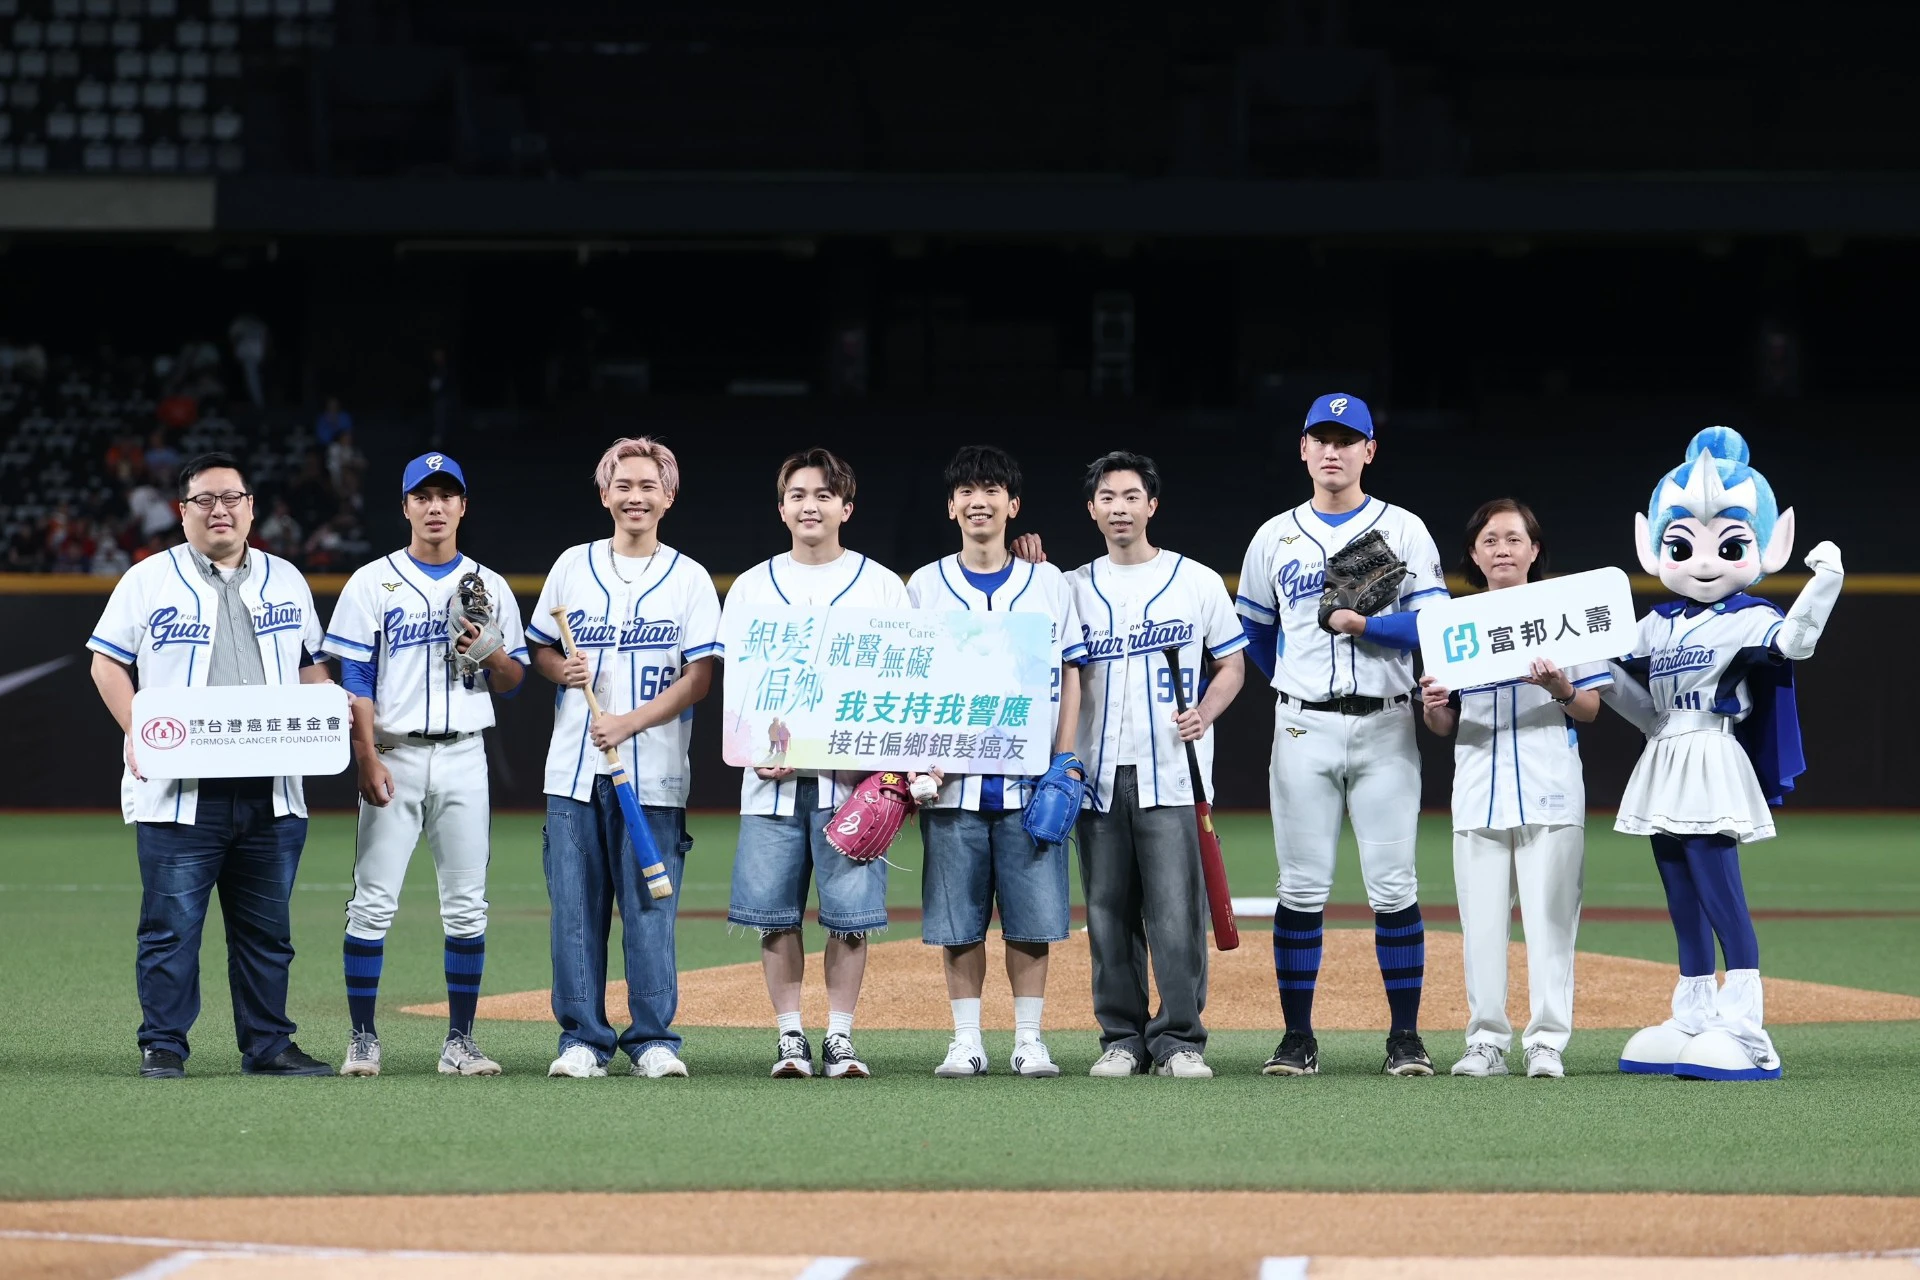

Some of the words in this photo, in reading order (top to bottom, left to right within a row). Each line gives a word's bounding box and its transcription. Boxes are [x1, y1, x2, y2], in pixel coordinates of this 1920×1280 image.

[869, 618, 911, 629] Cancer
[908, 628, 936, 639] Care
[1487, 605, 1613, 654] 富邦人壽
[640, 666, 676, 700] 66
[834, 690, 1033, 727] 我支持我響應
[208, 716, 341, 733] 台灣癌症基金會
[190, 738, 236, 746] FORMOSA
[239, 736, 278, 745] CANCER
[280, 735, 342, 744] FOUNDATION
[827, 730, 1028, 760] 接住偏鄉銀髮癌友
